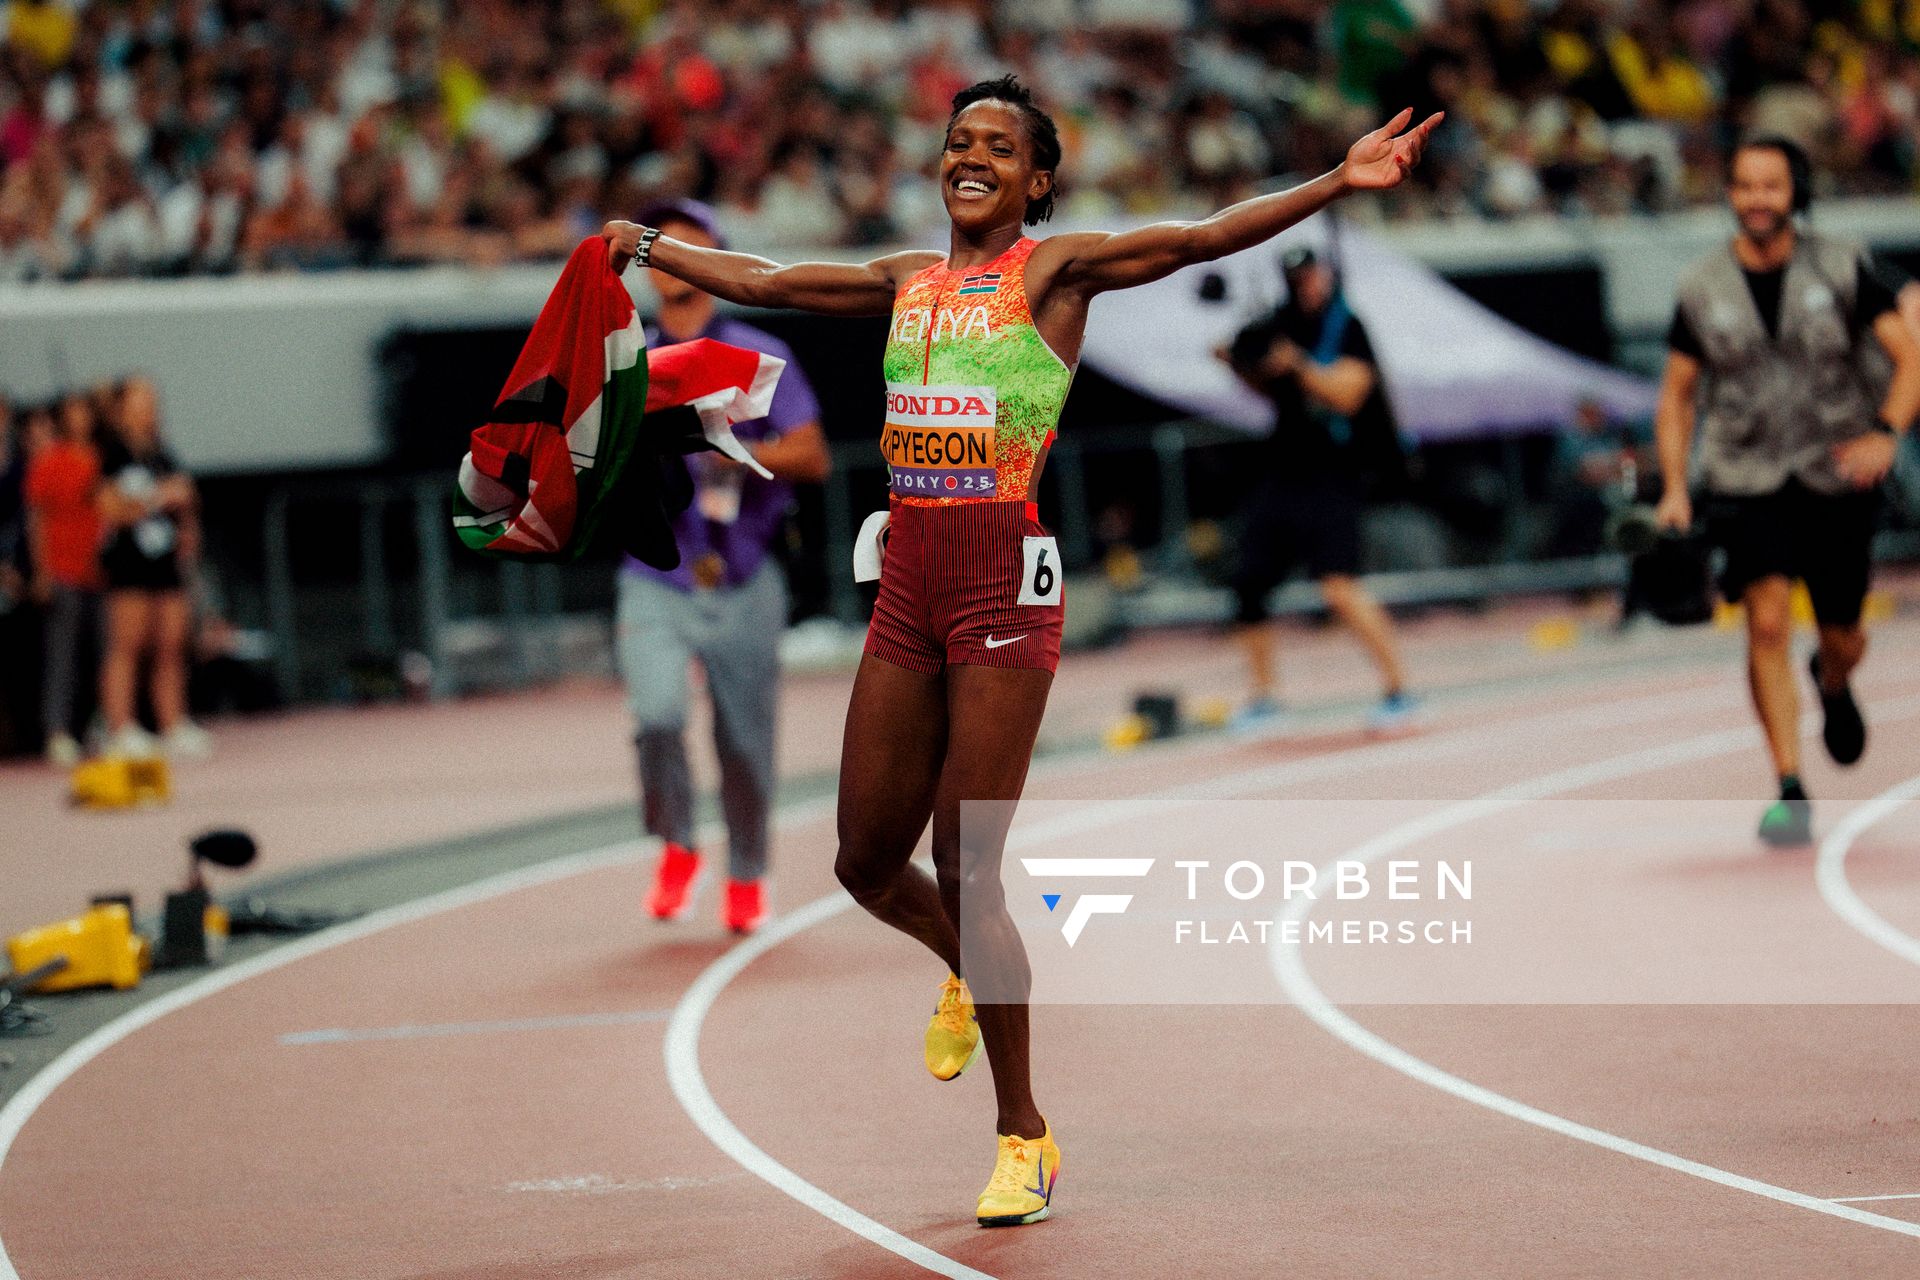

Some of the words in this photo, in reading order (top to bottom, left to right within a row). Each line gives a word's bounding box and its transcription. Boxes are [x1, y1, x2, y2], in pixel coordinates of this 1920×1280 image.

[892, 305, 991, 342] KENYA
[886, 392, 992, 416] HONDA
[882, 427, 987, 465] KIPYEGON
[1033, 547, 1054, 597] 6
